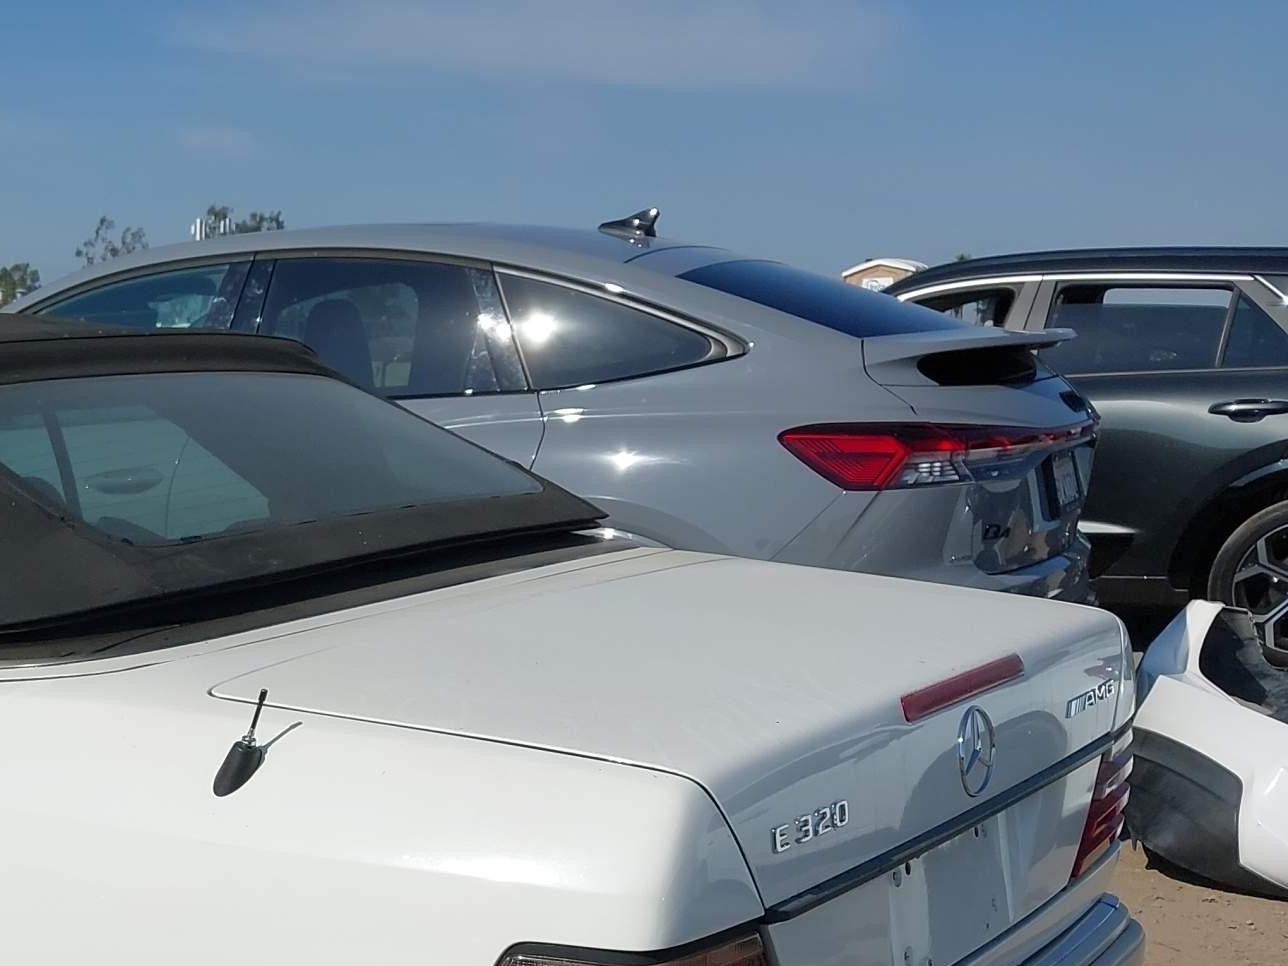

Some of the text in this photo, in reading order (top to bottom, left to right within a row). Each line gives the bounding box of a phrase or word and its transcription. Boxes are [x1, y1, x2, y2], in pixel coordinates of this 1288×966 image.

[1079, 677, 1115, 709] AMG
[771, 800, 849, 853] E 320
